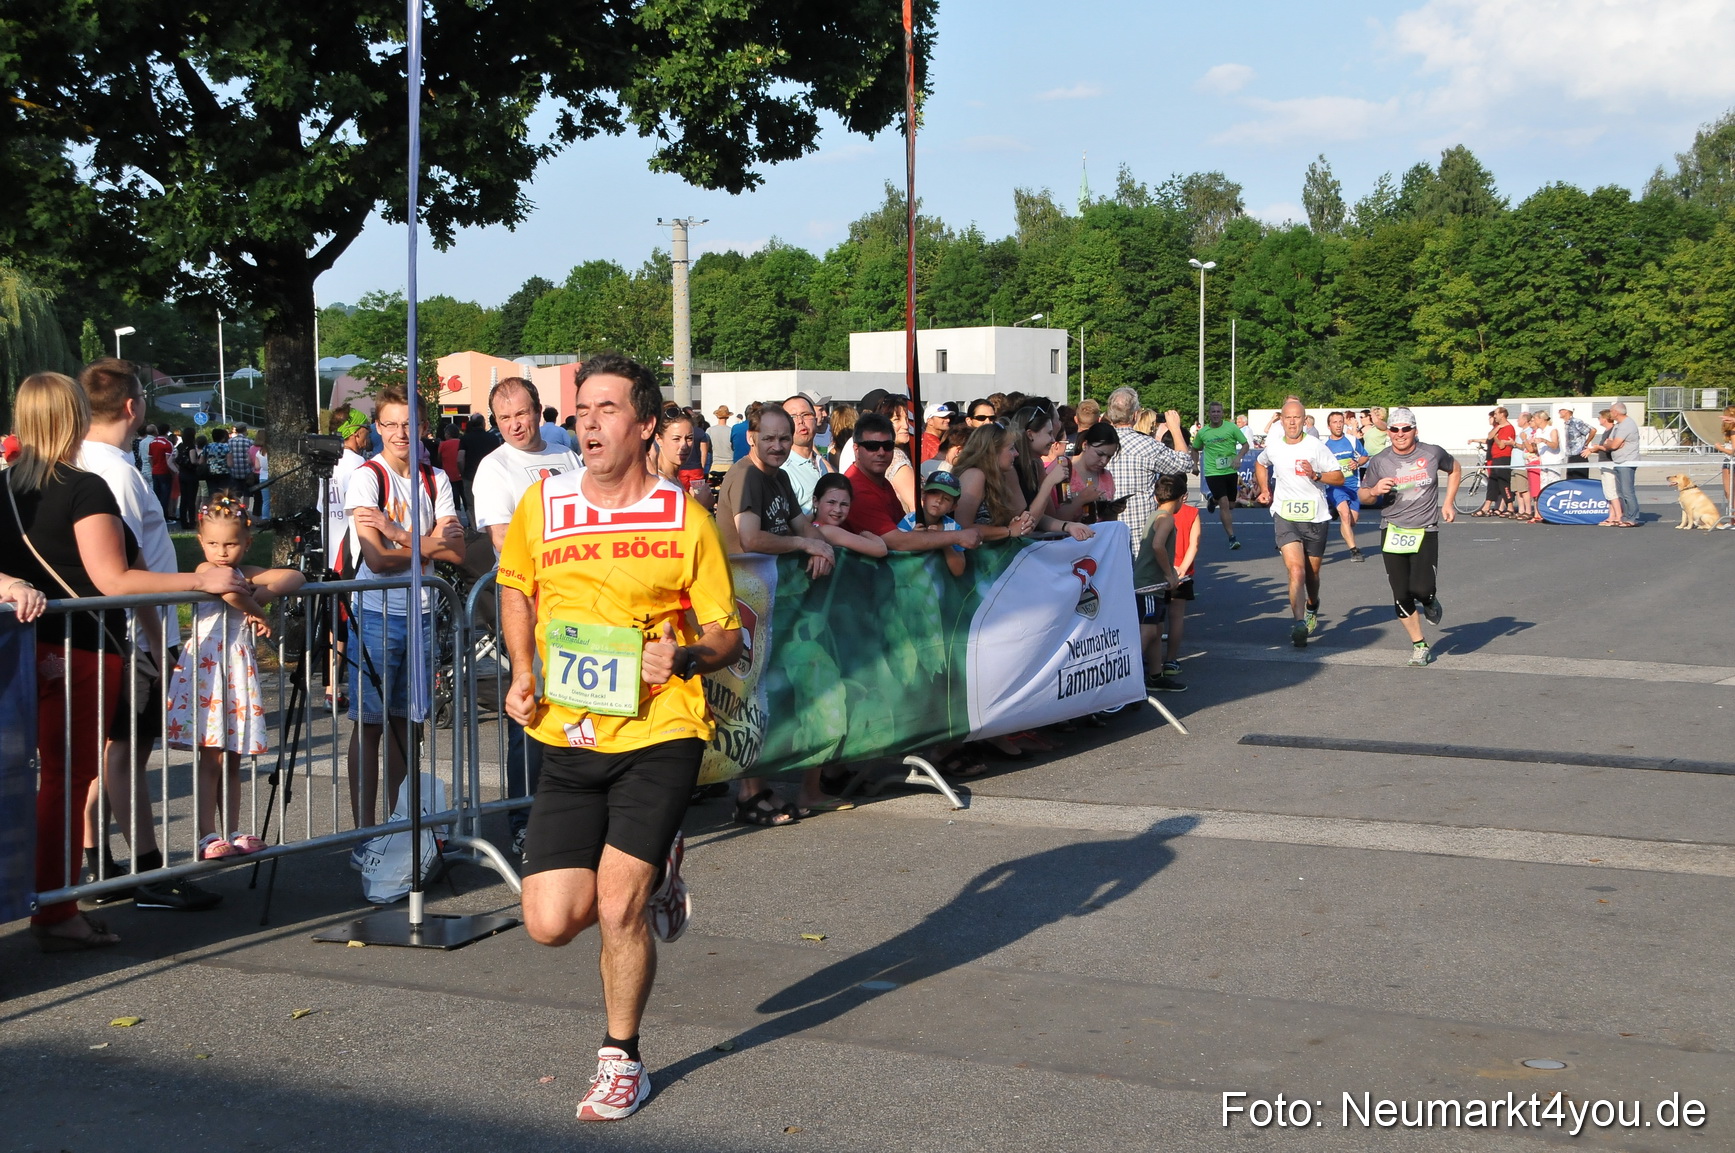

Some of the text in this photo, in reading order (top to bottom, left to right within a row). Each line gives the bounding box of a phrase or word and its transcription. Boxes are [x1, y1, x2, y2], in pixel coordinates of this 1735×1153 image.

[1286, 501, 1310, 514] 155
[542, 536, 685, 568] MAX BÖGL
[1391, 533, 1417, 547] 568
[1066, 627, 1120, 661] Neumarkter
[558, 650, 618, 692] 761
[1057, 649, 1131, 700] Lammsbräu
